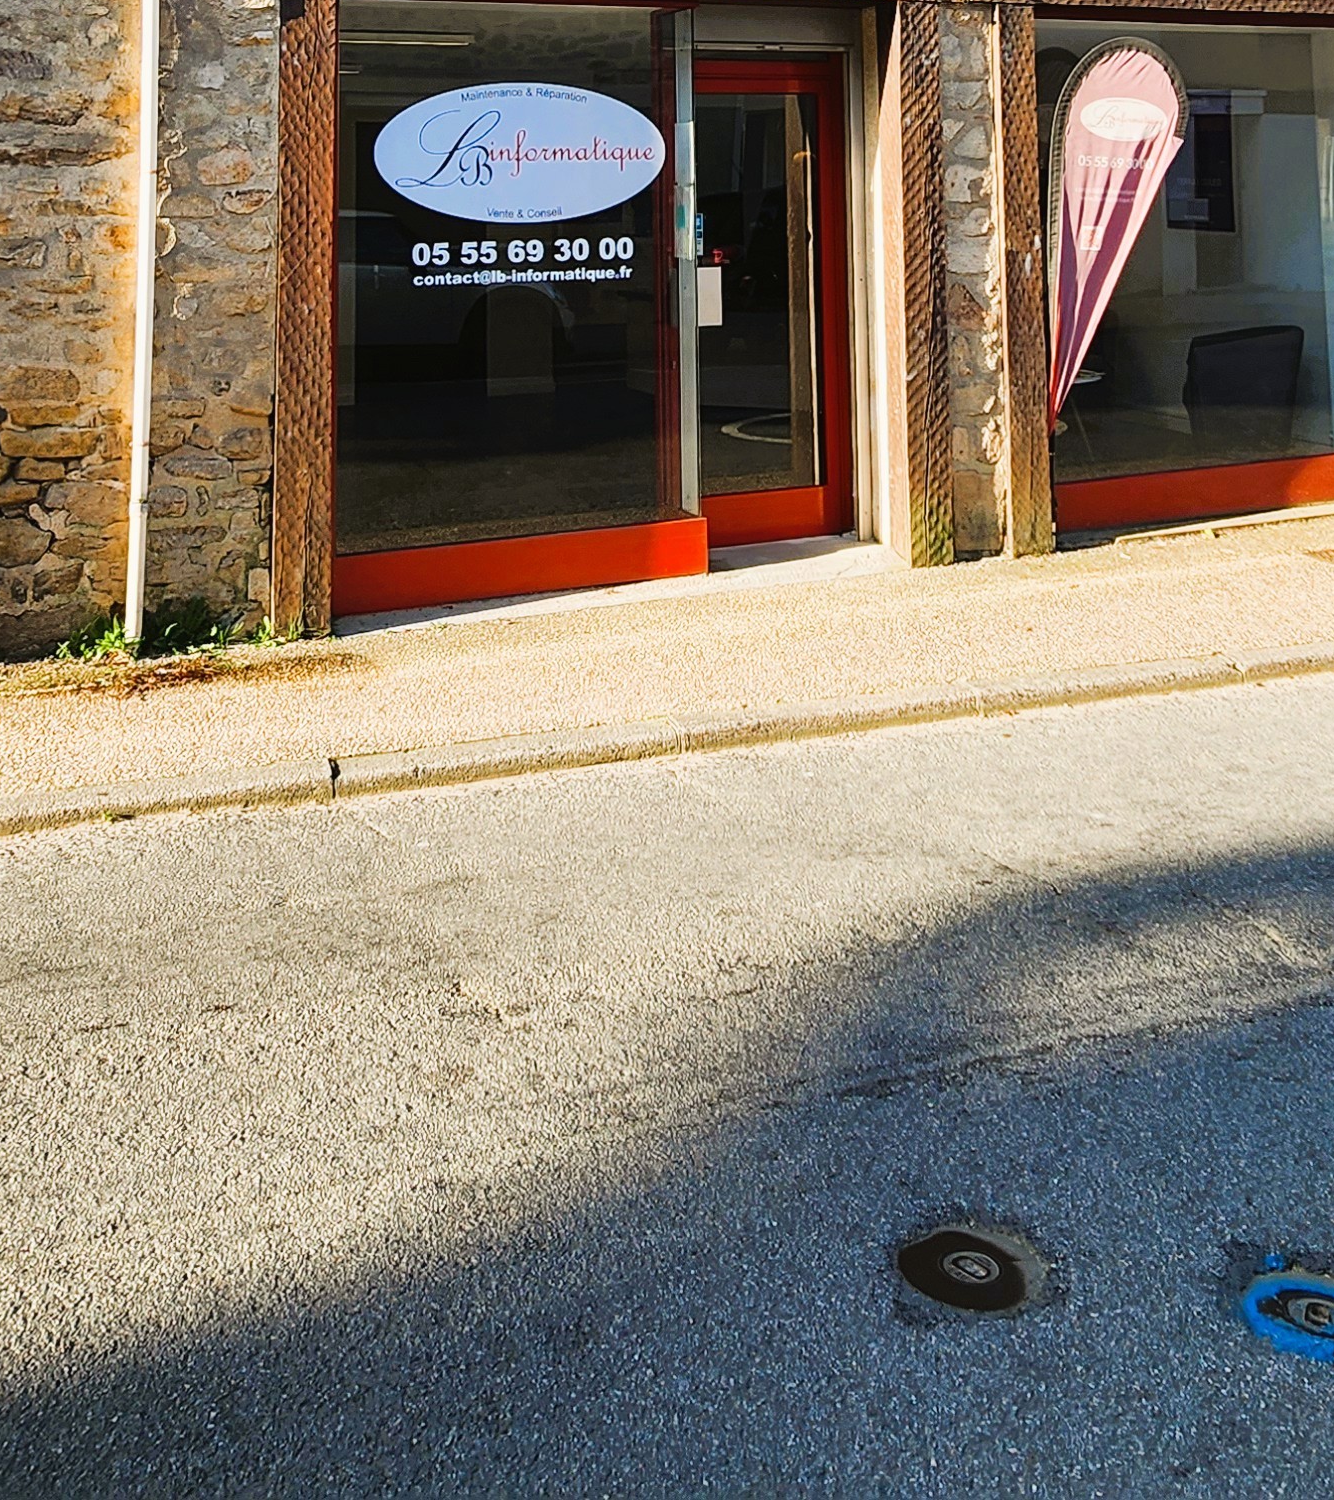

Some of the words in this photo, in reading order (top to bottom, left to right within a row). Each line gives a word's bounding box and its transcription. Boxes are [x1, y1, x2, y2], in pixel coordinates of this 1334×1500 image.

[461, 87, 523, 102] Maintenance
[526, 87, 533, 97] &
[535, 87, 588, 103] Réparation
[1078, 155, 1092, 167] 05
[1094, 156, 1108, 168] 55
[1110, 157, 1124, 169] 69
[487, 207, 514, 219] Vente
[517, 209, 524, 218] &
[527, 206, 563, 218] Conseil
[411, 242, 451, 266] 05
[460, 240, 498, 265] 55
[507, 239, 544, 263] 69
[553, 238, 590, 261] 30
[599, 236, 634, 260] 00
[413, 265, 633, 287] contact@lb-informatique.fr
